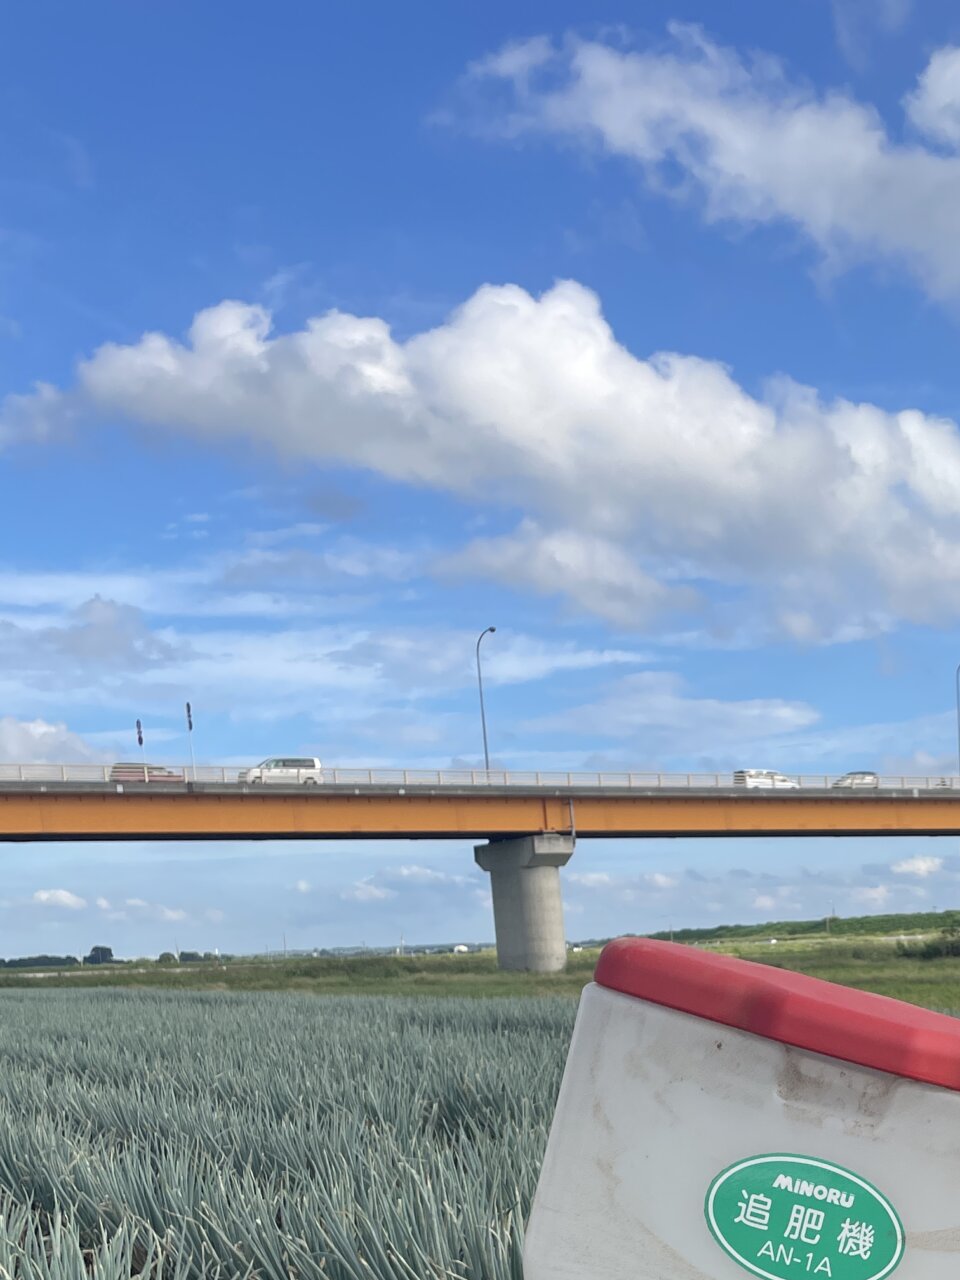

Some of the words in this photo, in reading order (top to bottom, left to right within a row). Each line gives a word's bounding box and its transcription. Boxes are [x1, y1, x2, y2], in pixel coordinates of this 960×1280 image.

[772, 1174, 855, 1208] MINORU
[733, 1189, 875, 1260] 追肥機
[757, 1240, 833, 1277] AN-1A
